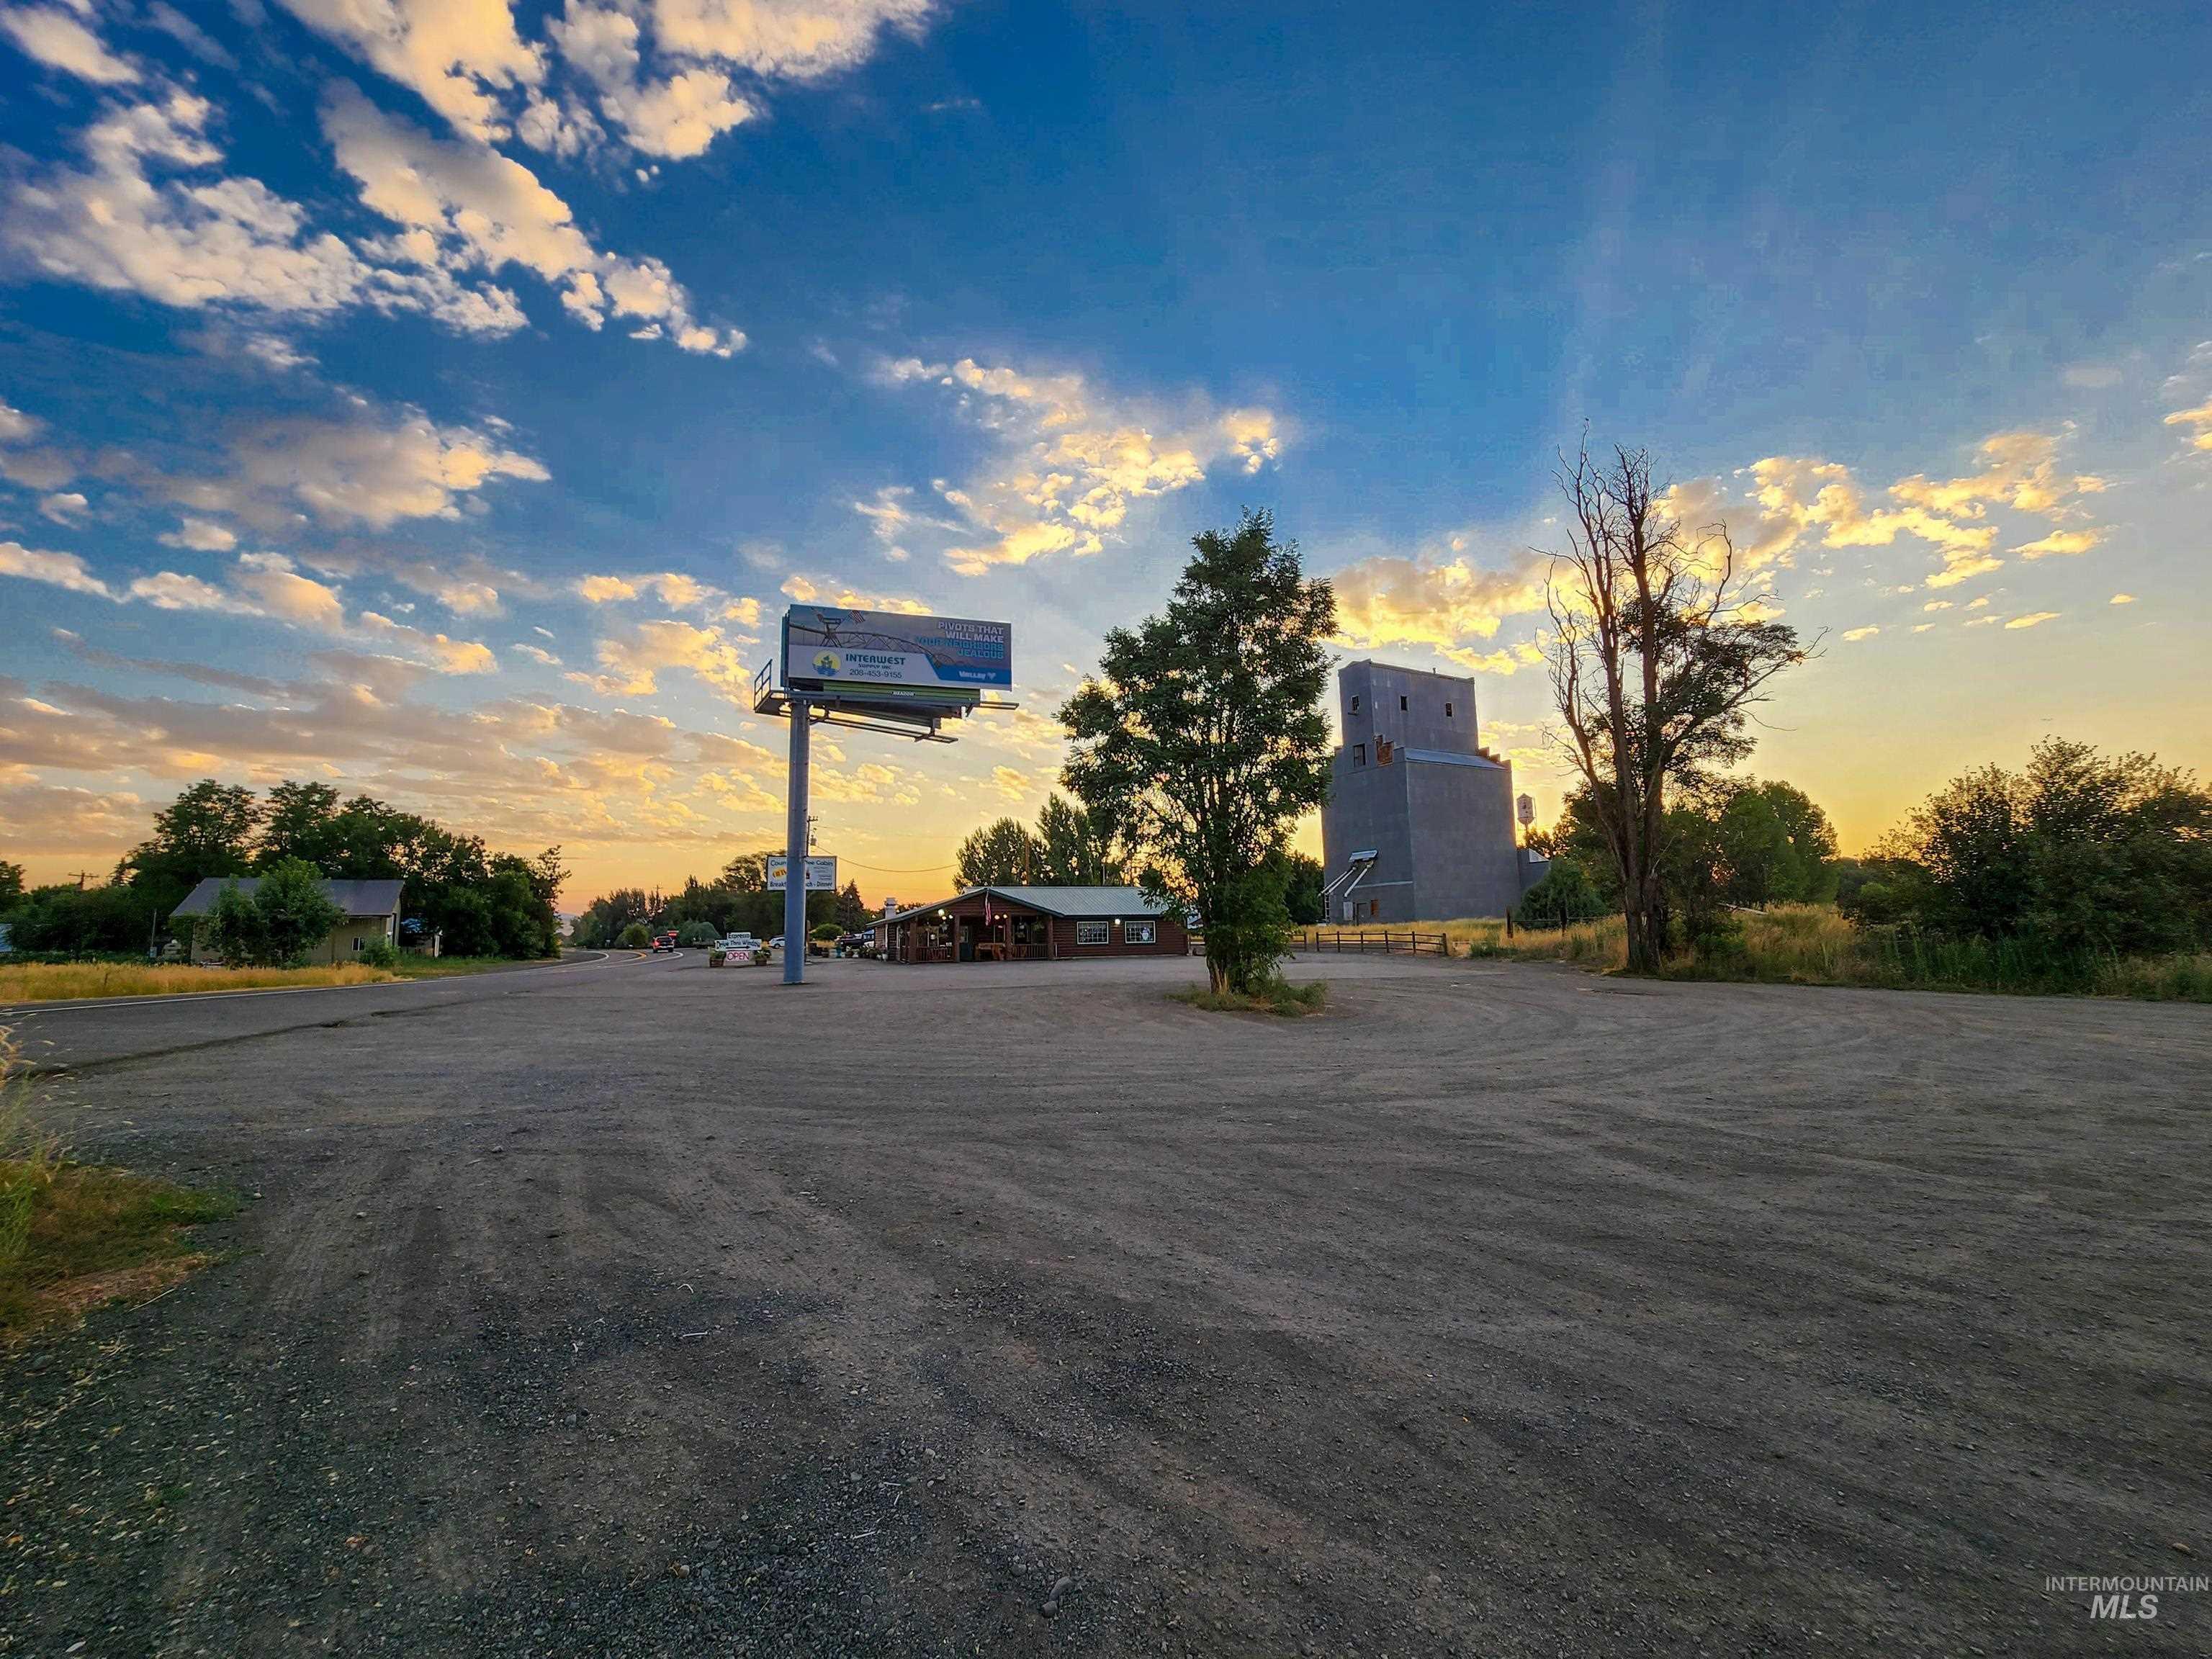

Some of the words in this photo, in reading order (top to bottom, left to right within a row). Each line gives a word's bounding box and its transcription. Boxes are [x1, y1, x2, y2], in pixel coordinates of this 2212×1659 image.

[938, 621, 974, 632] PIVOTS
[976, 624, 1004, 634] THAT
[945, 631, 971, 640] WILL
[974, 633, 1004, 643] MAKE
[915, 637, 943, 646] YOUR
[945, 639, 1004, 651] NEIGHBORS
[845, 654, 906, 665] INTERWEST
[956, 649, 1004, 659] JEALOUS
[727, 952, 749, 961] OPEN
